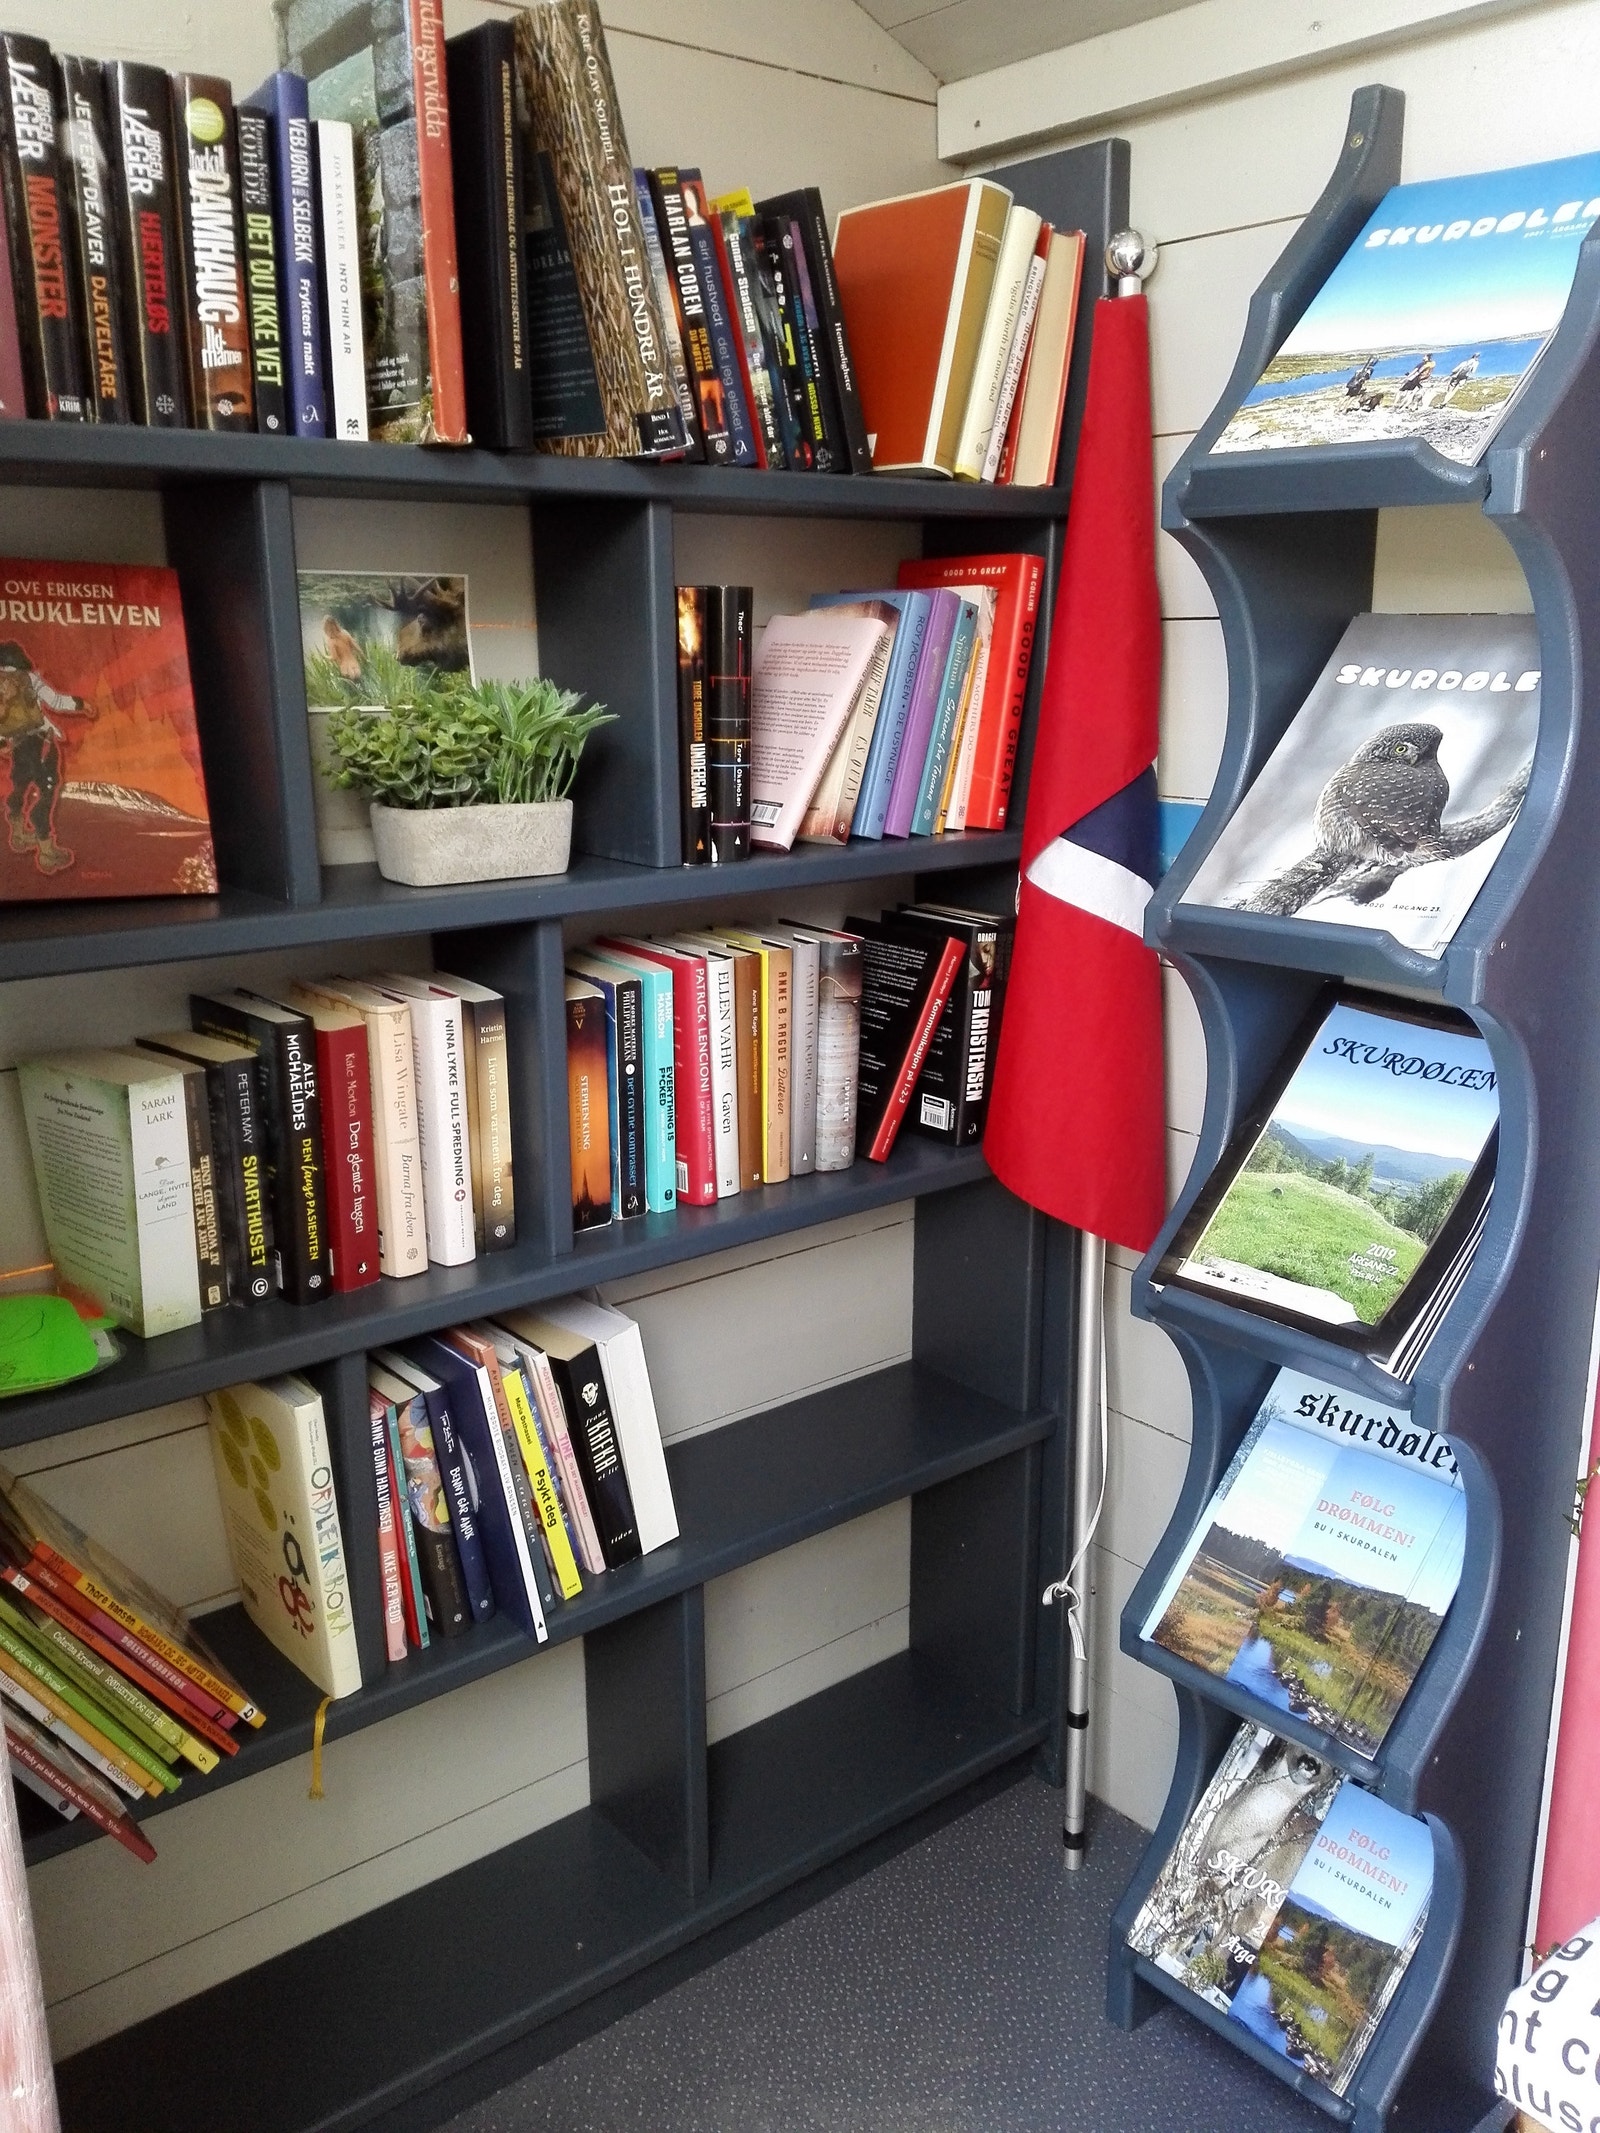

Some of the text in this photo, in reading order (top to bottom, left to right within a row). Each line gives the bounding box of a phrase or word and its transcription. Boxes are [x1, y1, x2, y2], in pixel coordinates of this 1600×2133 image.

[8, 57, 44, 160] JÆGER
[586, 55, 601, 95] OLAV
[74, 91, 104, 265] JEFFERY DEAVER
[122, 103, 153, 195] JÆGER
[288, 118, 309, 187] VEBJØRN
[27, 174, 68, 319] MONSTER
[188, 169, 240, 323] DAMHAUG
[293, 198, 315, 263] SELBEKK
[664, 194, 692, 257] HARLAN
[140, 211, 169, 334] HJERTELØS
[246, 213, 281, 386] DET IKKE VET
[608, 183, 664, 402] HOL HUNDRE ÅR
[677, 264, 705, 315] COBEN
[698, 239, 724, 328] siri hustvedt
[730, 232, 757, 333] Gunnar Staalesen
[91, 275, 117, 400] DJEVELTÅRE
[298, 278, 315, 376] Fryktens makt
[339, 263, 352, 355] INTO THIN AIR
[835, 322, 852, 392] Hemmeligheter
[58, 400, 81, 413] KRIM
[807, 382, 819, 415] FOSSUM
[5, 580, 114, 599] OVE ERIKSEN
[943, 566, 1006, 577] GOOD TO GREAT
[692, 680, 704, 741] TORE OKSHOLEN
[862, 687, 879, 718] TAKER
[884, 616, 926, 785] ROY JACOBSEN DE USYNLIGE
[926, 633, 968, 802] Spielman Toscana
[966, 651, 987, 752] WHAT MOTHERS DO
[999, 581, 1038, 798] COLLINS GOOD TO GREAT
[689, 743, 707, 808] UNDERGANG
[777, 971, 787, 1002] ANNE
[972, 989, 991, 1007] TOM
[695, 967, 710, 1093] PATRICK LENCIONI
[718, 971, 734, 1134] ELLEN VAHR Gaven
[776, 1023, 787, 1062] RAGDE
[910, 998, 942, 1069] Kommunikasjon
[966, 1008, 991, 1102] KRISTENSEN
[1322, 1036, 1499, 1093] SKURDØLEN
[141, 1096, 175, 1111] SARAH
[237, 1073, 254, 1144] PETER MAY
[286, 1034, 306, 1131] MICHAELIDES
[302, 1062, 316, 1099] ALEX
[444, 1019, 465, 1187] NINA LYKKE FULL SPREDNING
[580, 1075, 591, 1150] STEPHEN KING
[665, 1065, 674, 1128] EVERYTHING
[777, 1067, 788, 1117] Datteren
[146, 1111, 174, 1125] LARK
[344, 1053, 366, 1234] Kate Morton Den glemte hagen
[393, 1032, 417, 1238] Lisa Wingate Barna elven
[488, 1057, 505, 1207] Livet som ment for deg
[156, 1201, 177, 1211] LAND
[192, 1167, 204, 1205] HEART
[200, 1154, 218, 1250] WOUNDED KNEE
[242, 1154, 266, 1267] SVARTHUSET
[301, 1137, 319, 1260] DEN tause PASIENTEN
[198, 1229, 210, 1260] BURY
[1349, 1252, 1388, 1274] ÅRGANG
[1366, 1242, 1397, 1260] 2019
[371, 1419, 393, 1533] ANNE GUNN HALVORSEN
[558, 1433, 574, 1460] TINE
[588, 1417, 618, 1474] KAFKA
[449, 1465, 475, 1541] BENNY GÅR AMOK
[534, 1469, 558, 1528] Psykt deg
[1316, 1499, 1417, 1549] DRØMMEN!
[1350, 1489, 1397, 1518] FØLG
[311, 1466, 353, 1639] ORDLEIKSBOKA
[1313, 1521, 1399, 1563] BU SKURDALEN
[85, 1582, 109, 1604] Thore
[383, 1551, 402, 1624] IKKE VÆR REDD
[1316, 1834, 1409, 1897] DRØMMEN!
[1347, 1828, 1391, 1861] FØLG
[1313, 1857, 1393, 1910] BU SKURDALEN
